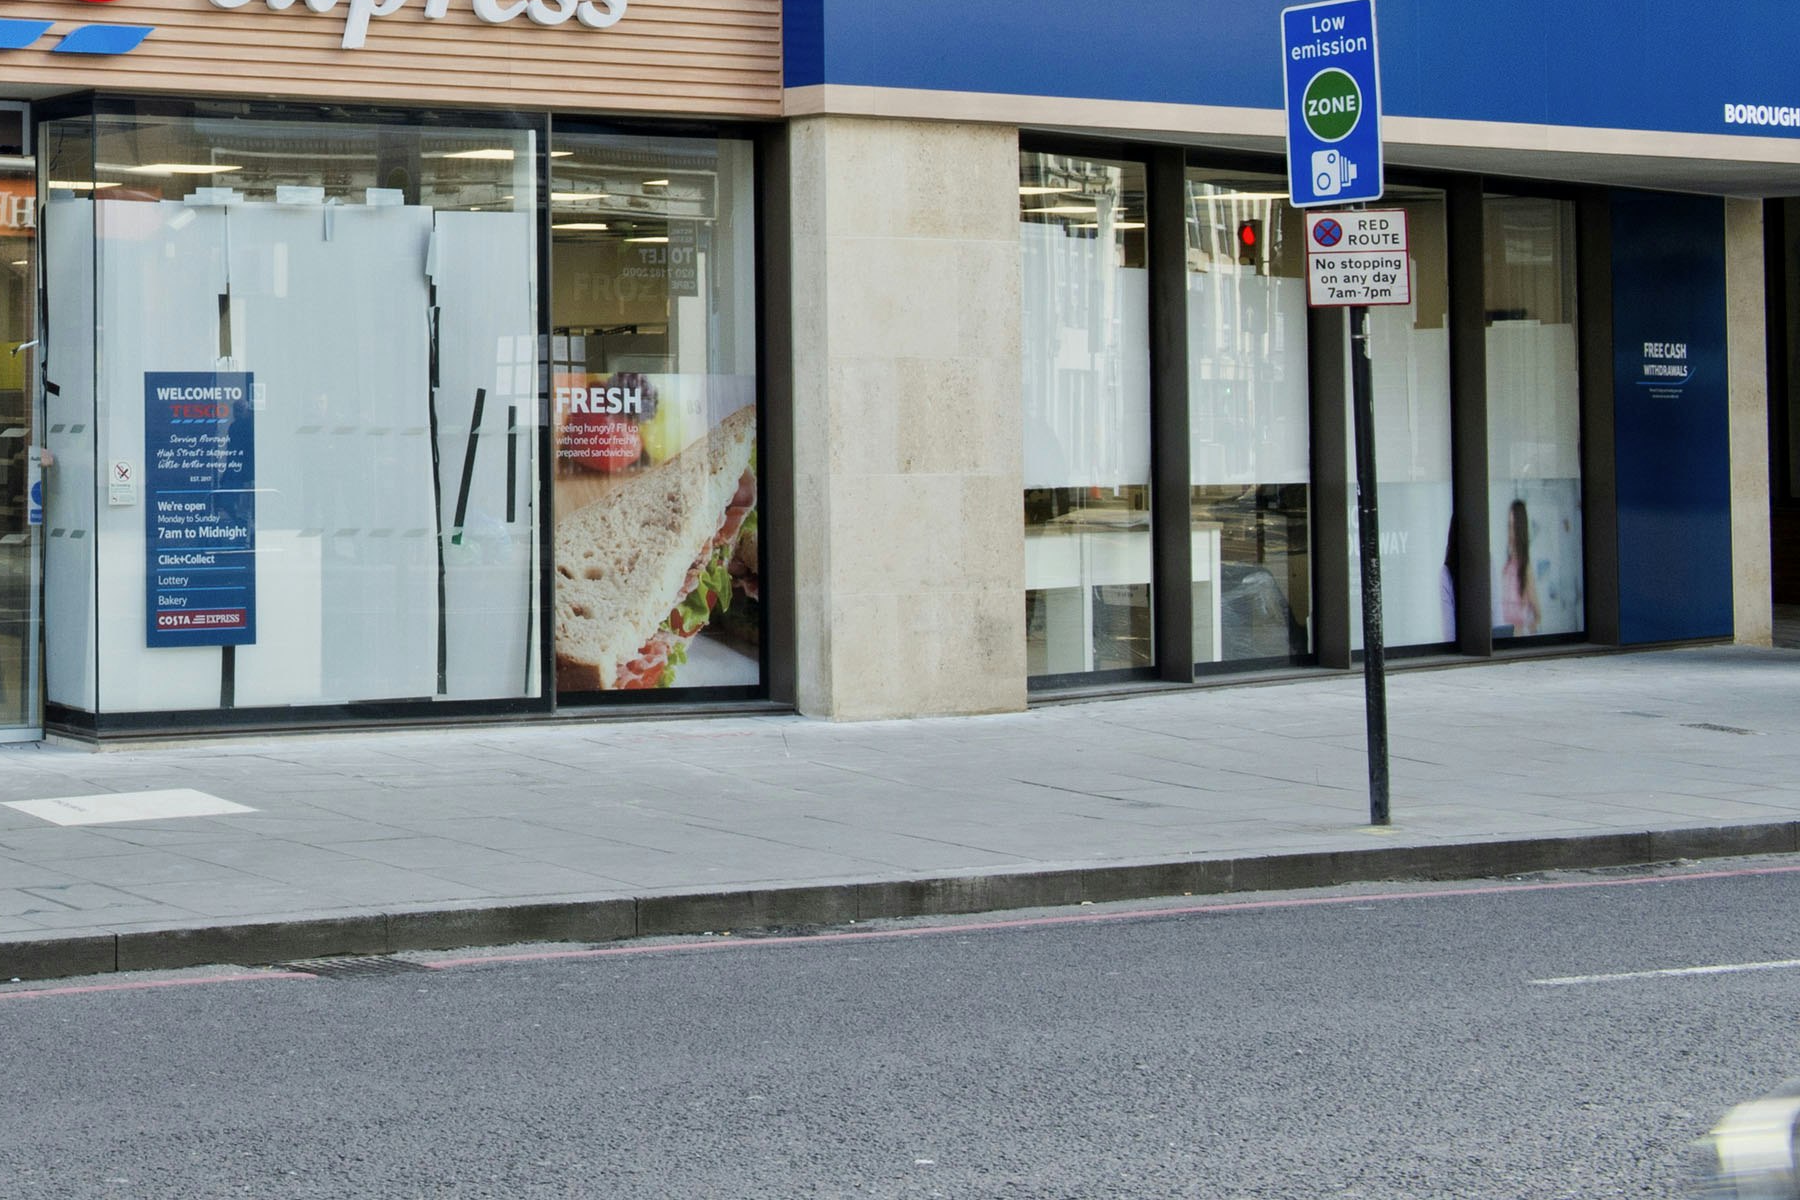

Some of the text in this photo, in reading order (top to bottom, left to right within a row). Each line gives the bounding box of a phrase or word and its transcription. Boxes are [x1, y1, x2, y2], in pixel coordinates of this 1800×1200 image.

[1312, 15, 1345, 33] Low
[1291, 36, 1367, 60] emission
[1308, 94, 1356, 116] ZONE
[1724, 103, 1800, 126] BOROUGH
[1358, 219, 1389, 231] RED
[1348, 233, 1400, 245] ROUTE
[1316, 257, 1401, 270] No stopping
[1321, 272, 1397, 285] on any day
[1328, 286, 1391, 299] 7am-7pm
[1644, 342, 1687, 359] FREE CASH
[1643, 364, 1688, 377] WITHDRAWALS
[157, 387, 242, 400] WELCOME TO
[556, 387, 642, 414] FRESH
[169, 403, 230, 418] TESCO
[557, 423, 583, 434] Feeling
[584, 423, 615, 434] hungry?
[573, 436, 589, 445] one
[589, 435, 598, 445] of
[598, 436, 613, 445] our
[556, 448, 634, 458] prepared sandwiches
[157, 501, 206, 513] We're open
[157, 513, 220, 524] Monday to Sunday
[158, 525, 247, 540] 7am to Midnight
[158, 554, 215, 564] Click+Collect
[158, 575, 189, 587] Lottery
[158, 595, 187, 606] Bakery
[158, 614, 240, 626] COSTA EXPRESS
